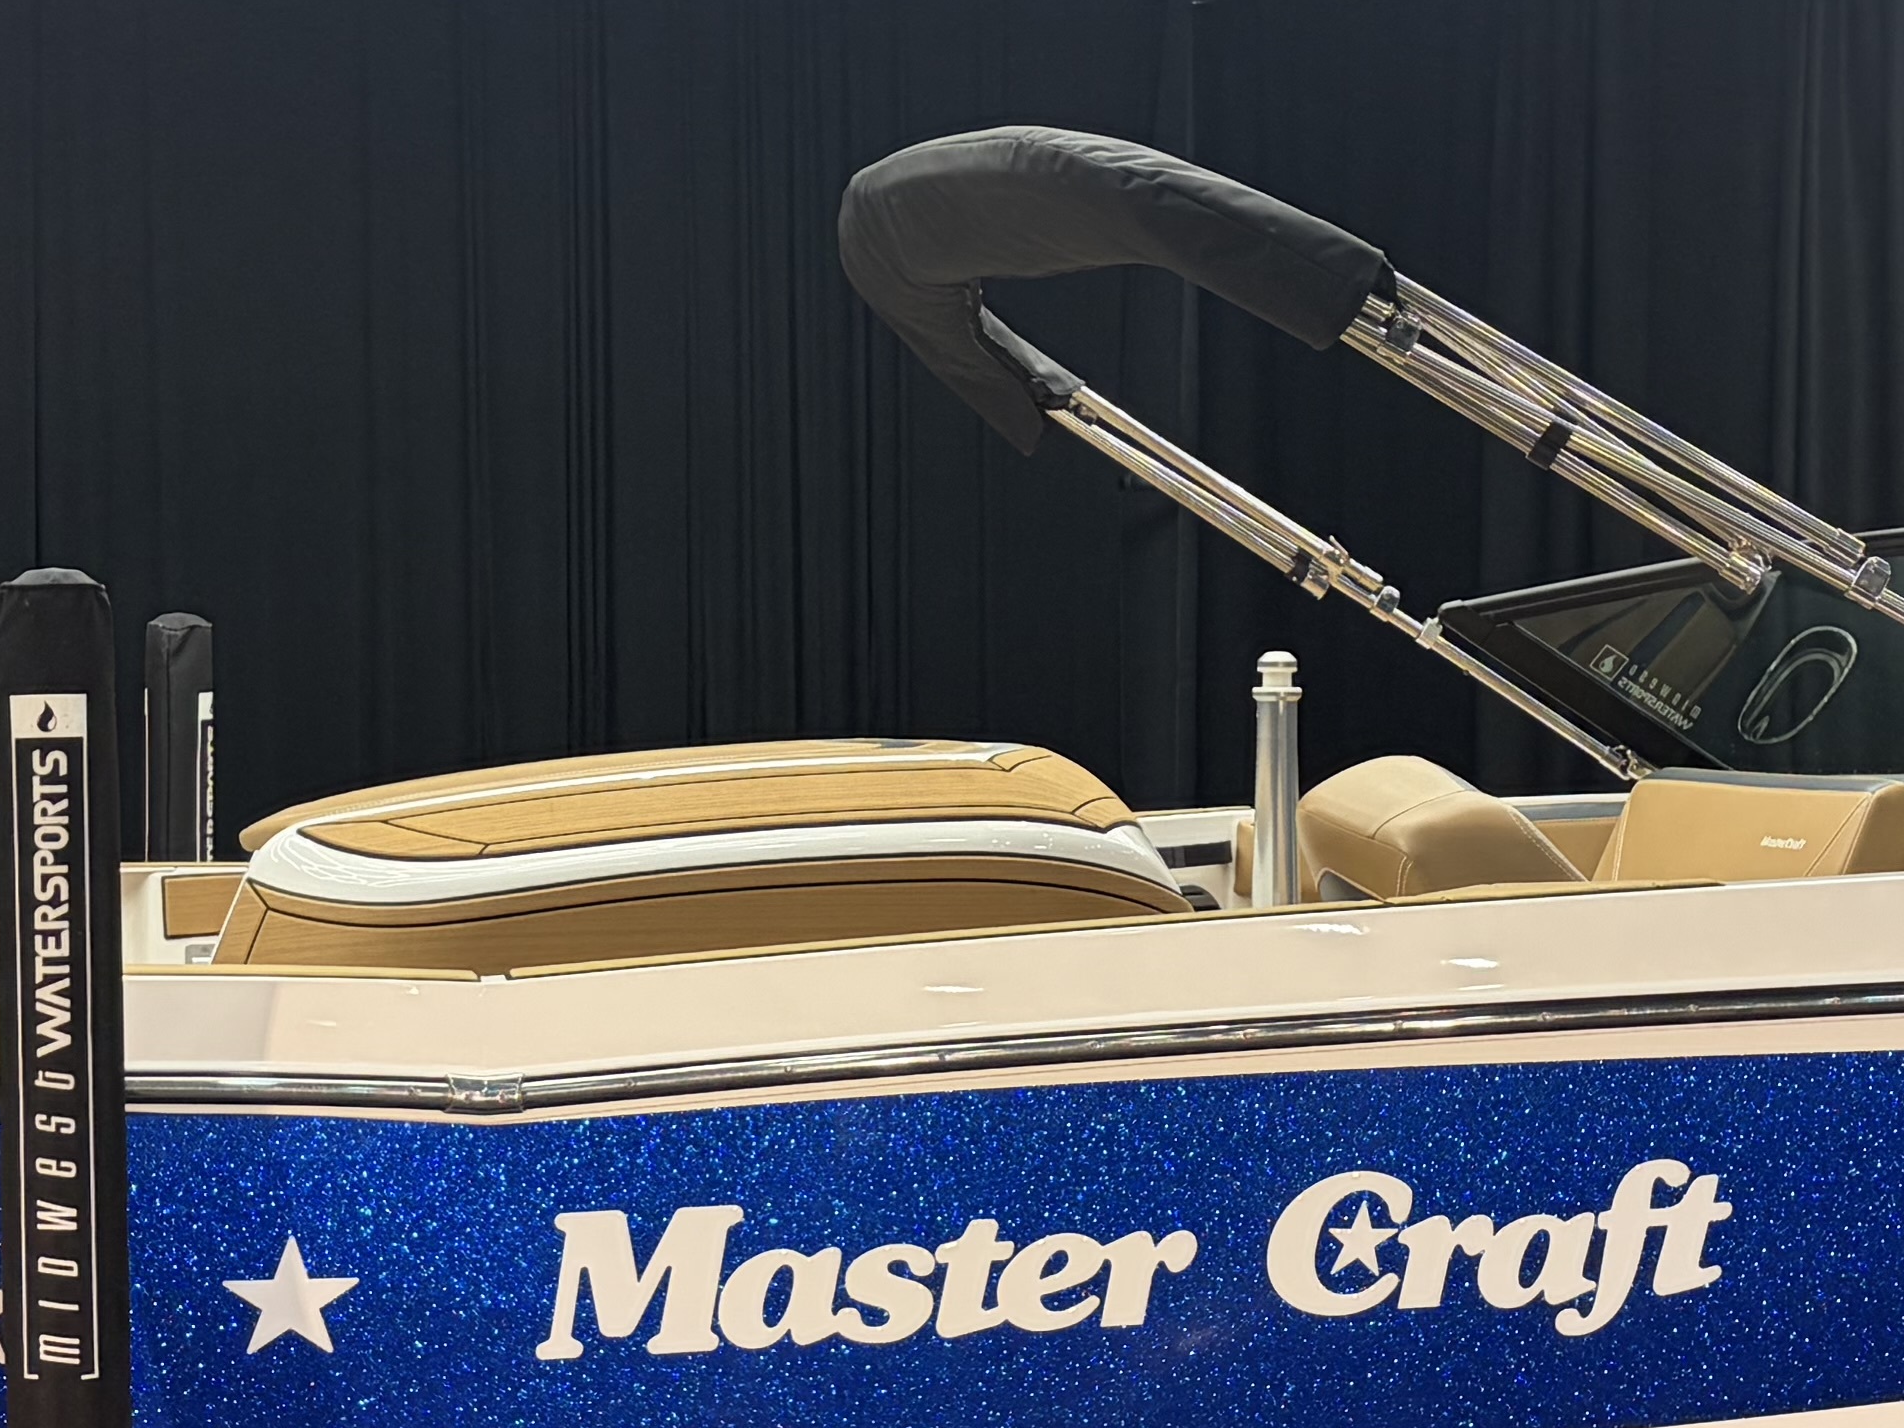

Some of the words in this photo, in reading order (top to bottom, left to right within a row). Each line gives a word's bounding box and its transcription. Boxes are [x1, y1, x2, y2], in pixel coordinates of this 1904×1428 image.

[32, 748, 70, 1059] WATERSPORTS
[535, 1204, 1197, 1361] Master
[1266, 1158, 1733, 1337] Craft
